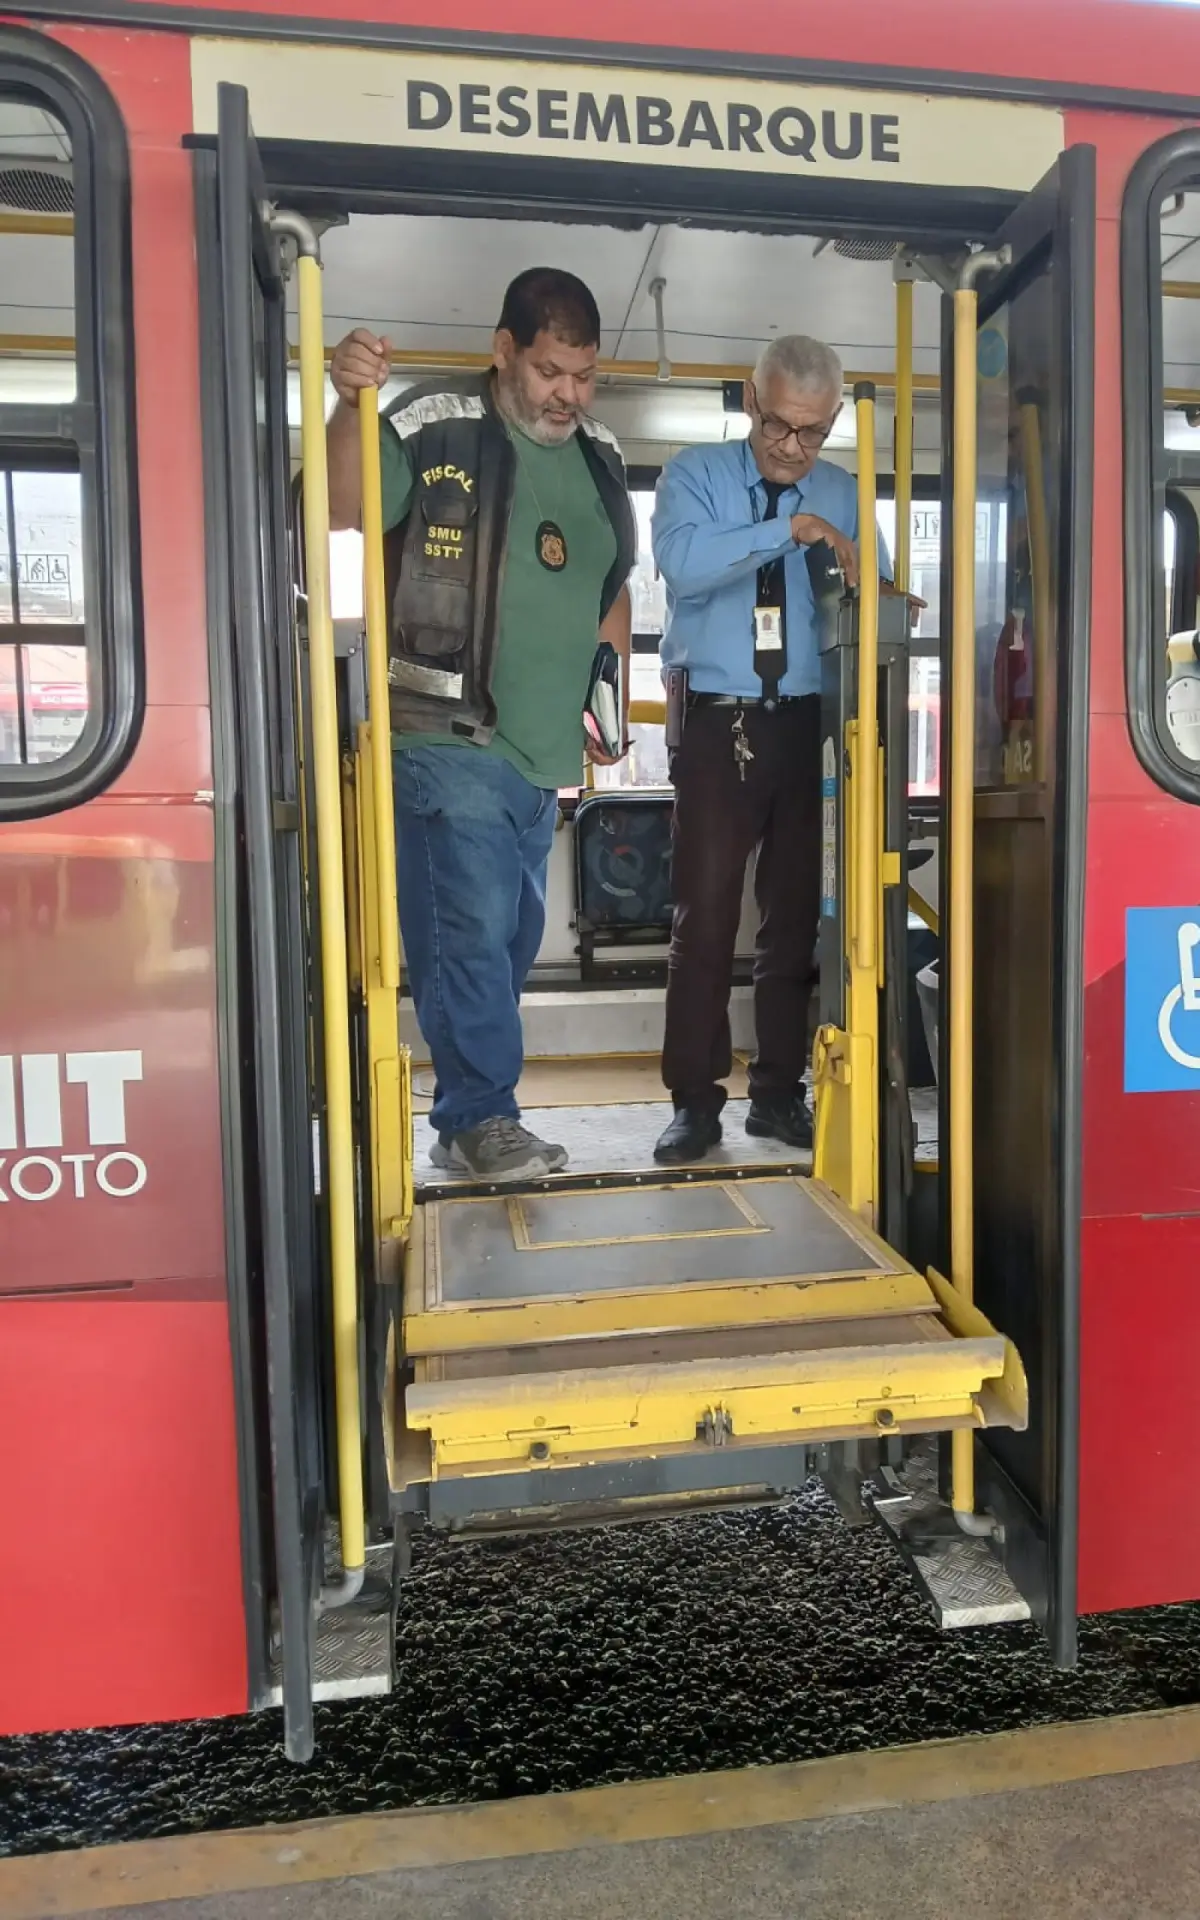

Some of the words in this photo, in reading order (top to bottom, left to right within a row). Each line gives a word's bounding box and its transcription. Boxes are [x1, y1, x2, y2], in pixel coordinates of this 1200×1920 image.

[406, 79, 900, 163] DESEMBARQUE
[422, 465, 474, 492] FISCAL
[428, 526, 461, 541] SMU
[424, 543, 462, 559] SSTT
